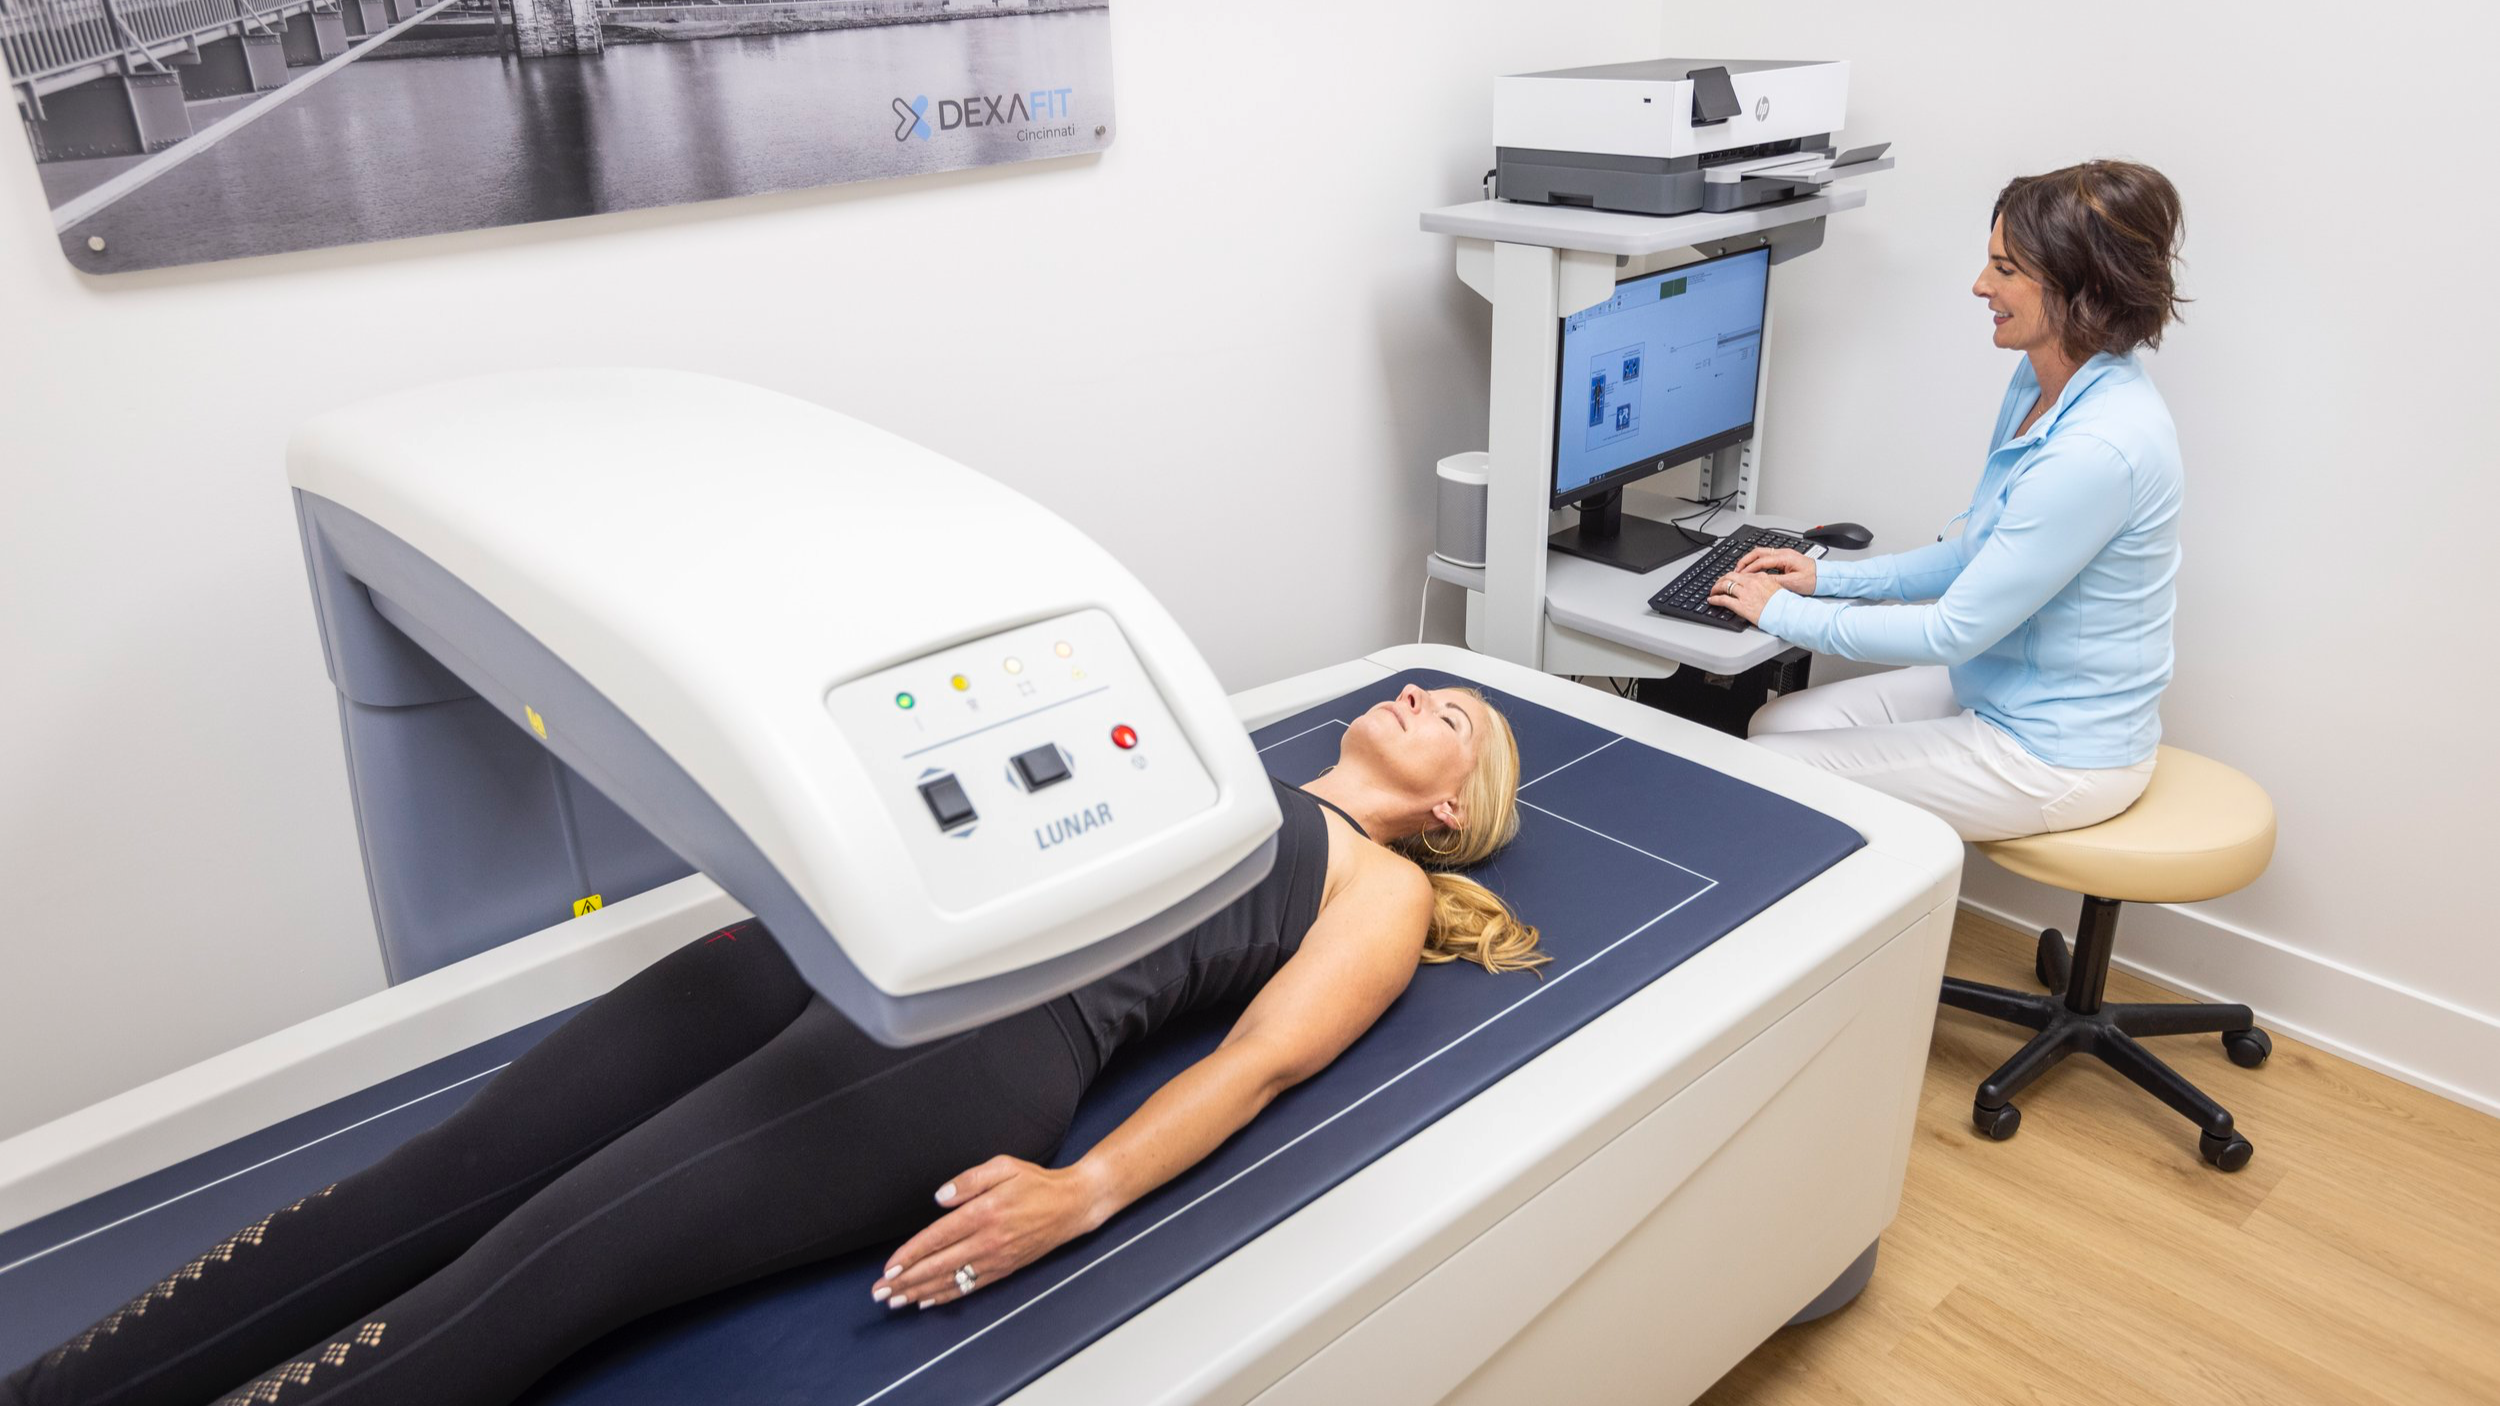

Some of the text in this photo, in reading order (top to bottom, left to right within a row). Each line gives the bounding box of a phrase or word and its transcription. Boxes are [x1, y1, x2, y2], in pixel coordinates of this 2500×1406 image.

[938, 88, 1072, 130] DEXAFIT
[1756, 96, 1769, 122] hp
[1016, 123, 1075, 142] Cincinnati
[1034, 802, 1114, 850] LUNAR
